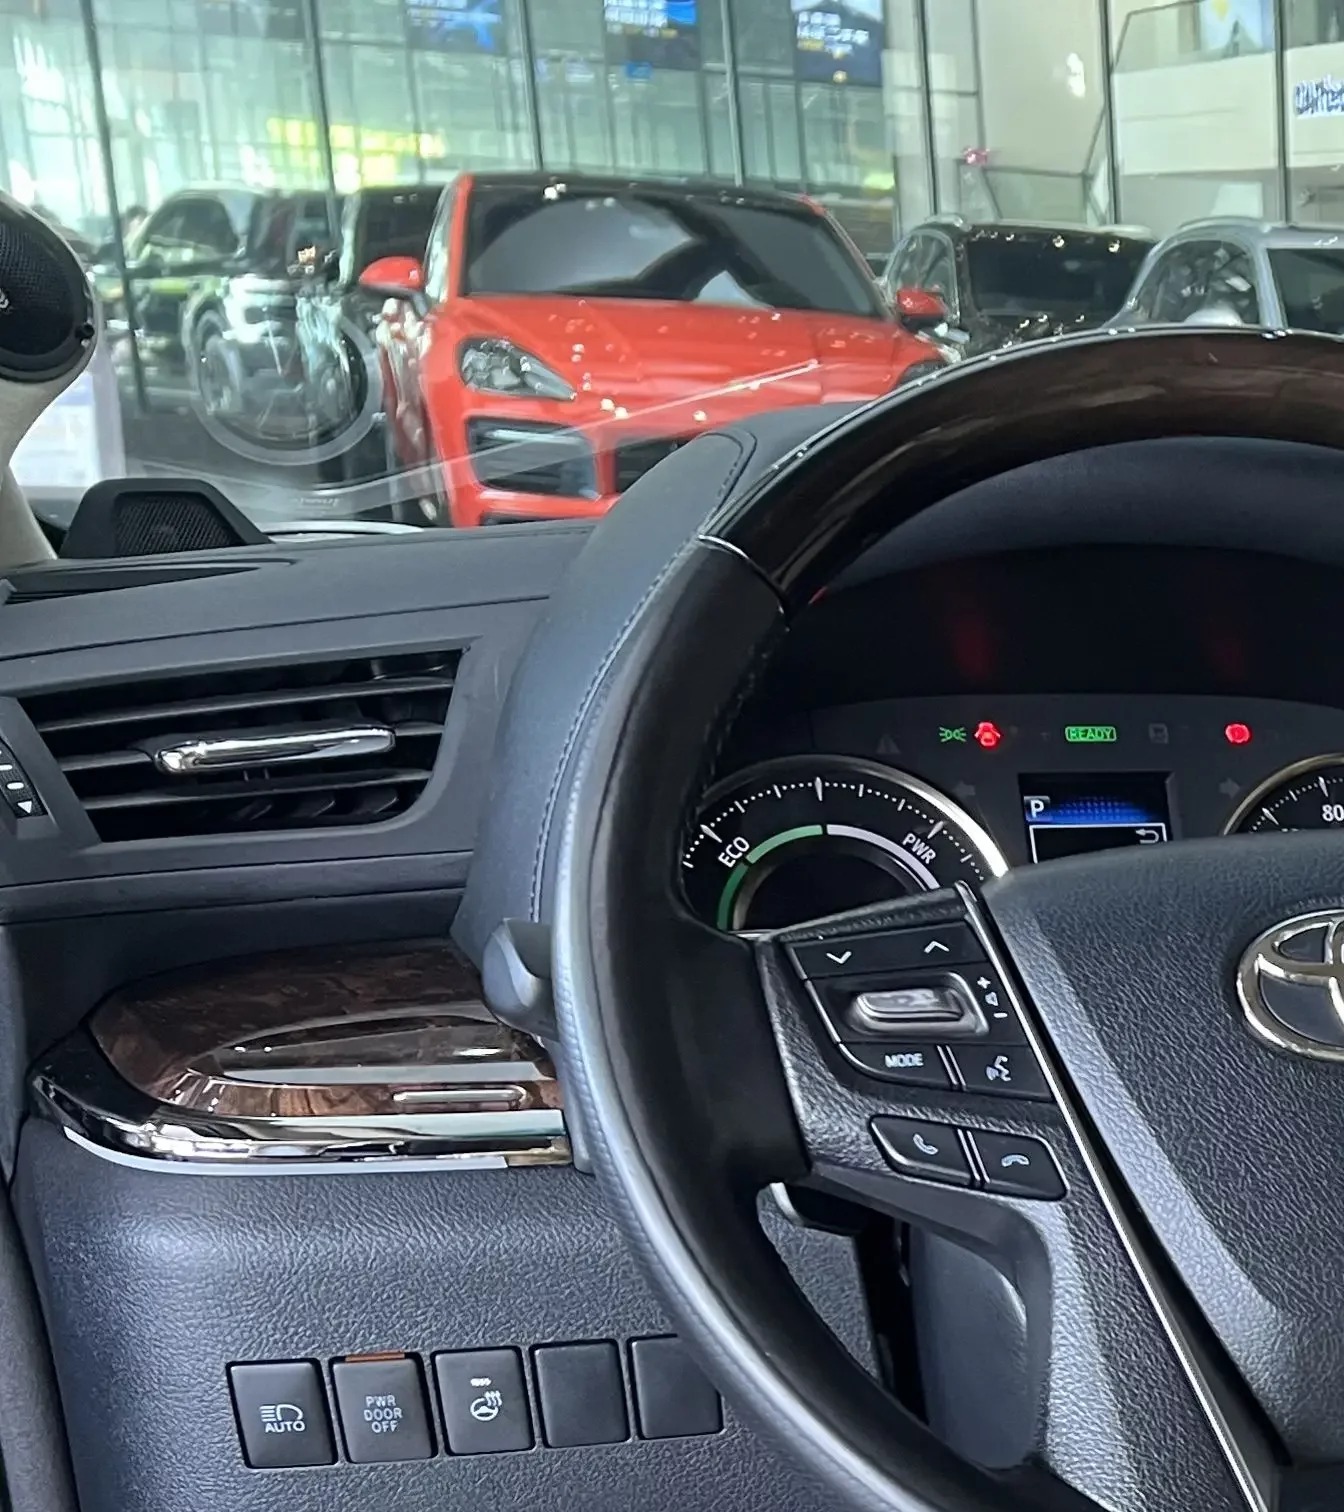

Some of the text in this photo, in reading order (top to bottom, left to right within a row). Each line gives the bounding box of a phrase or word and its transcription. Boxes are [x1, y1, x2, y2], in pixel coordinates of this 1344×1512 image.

[1070, 727, 1113, 740] READY
[1030, 800, 1044, 818] P
[1322, 804, 1344, 821] 80
[718, 836, 750, 867] ECO
[902, 833, 936, 865] PWR
[885, 1053, 923, 1068] MODE
[366, 1395, 396, 1407] PWR
[364, 1407, 403, 1421] DOOR
[265, 1421, 305, 1433] AUTO
[371, 1421, 398, 1433] OFF
